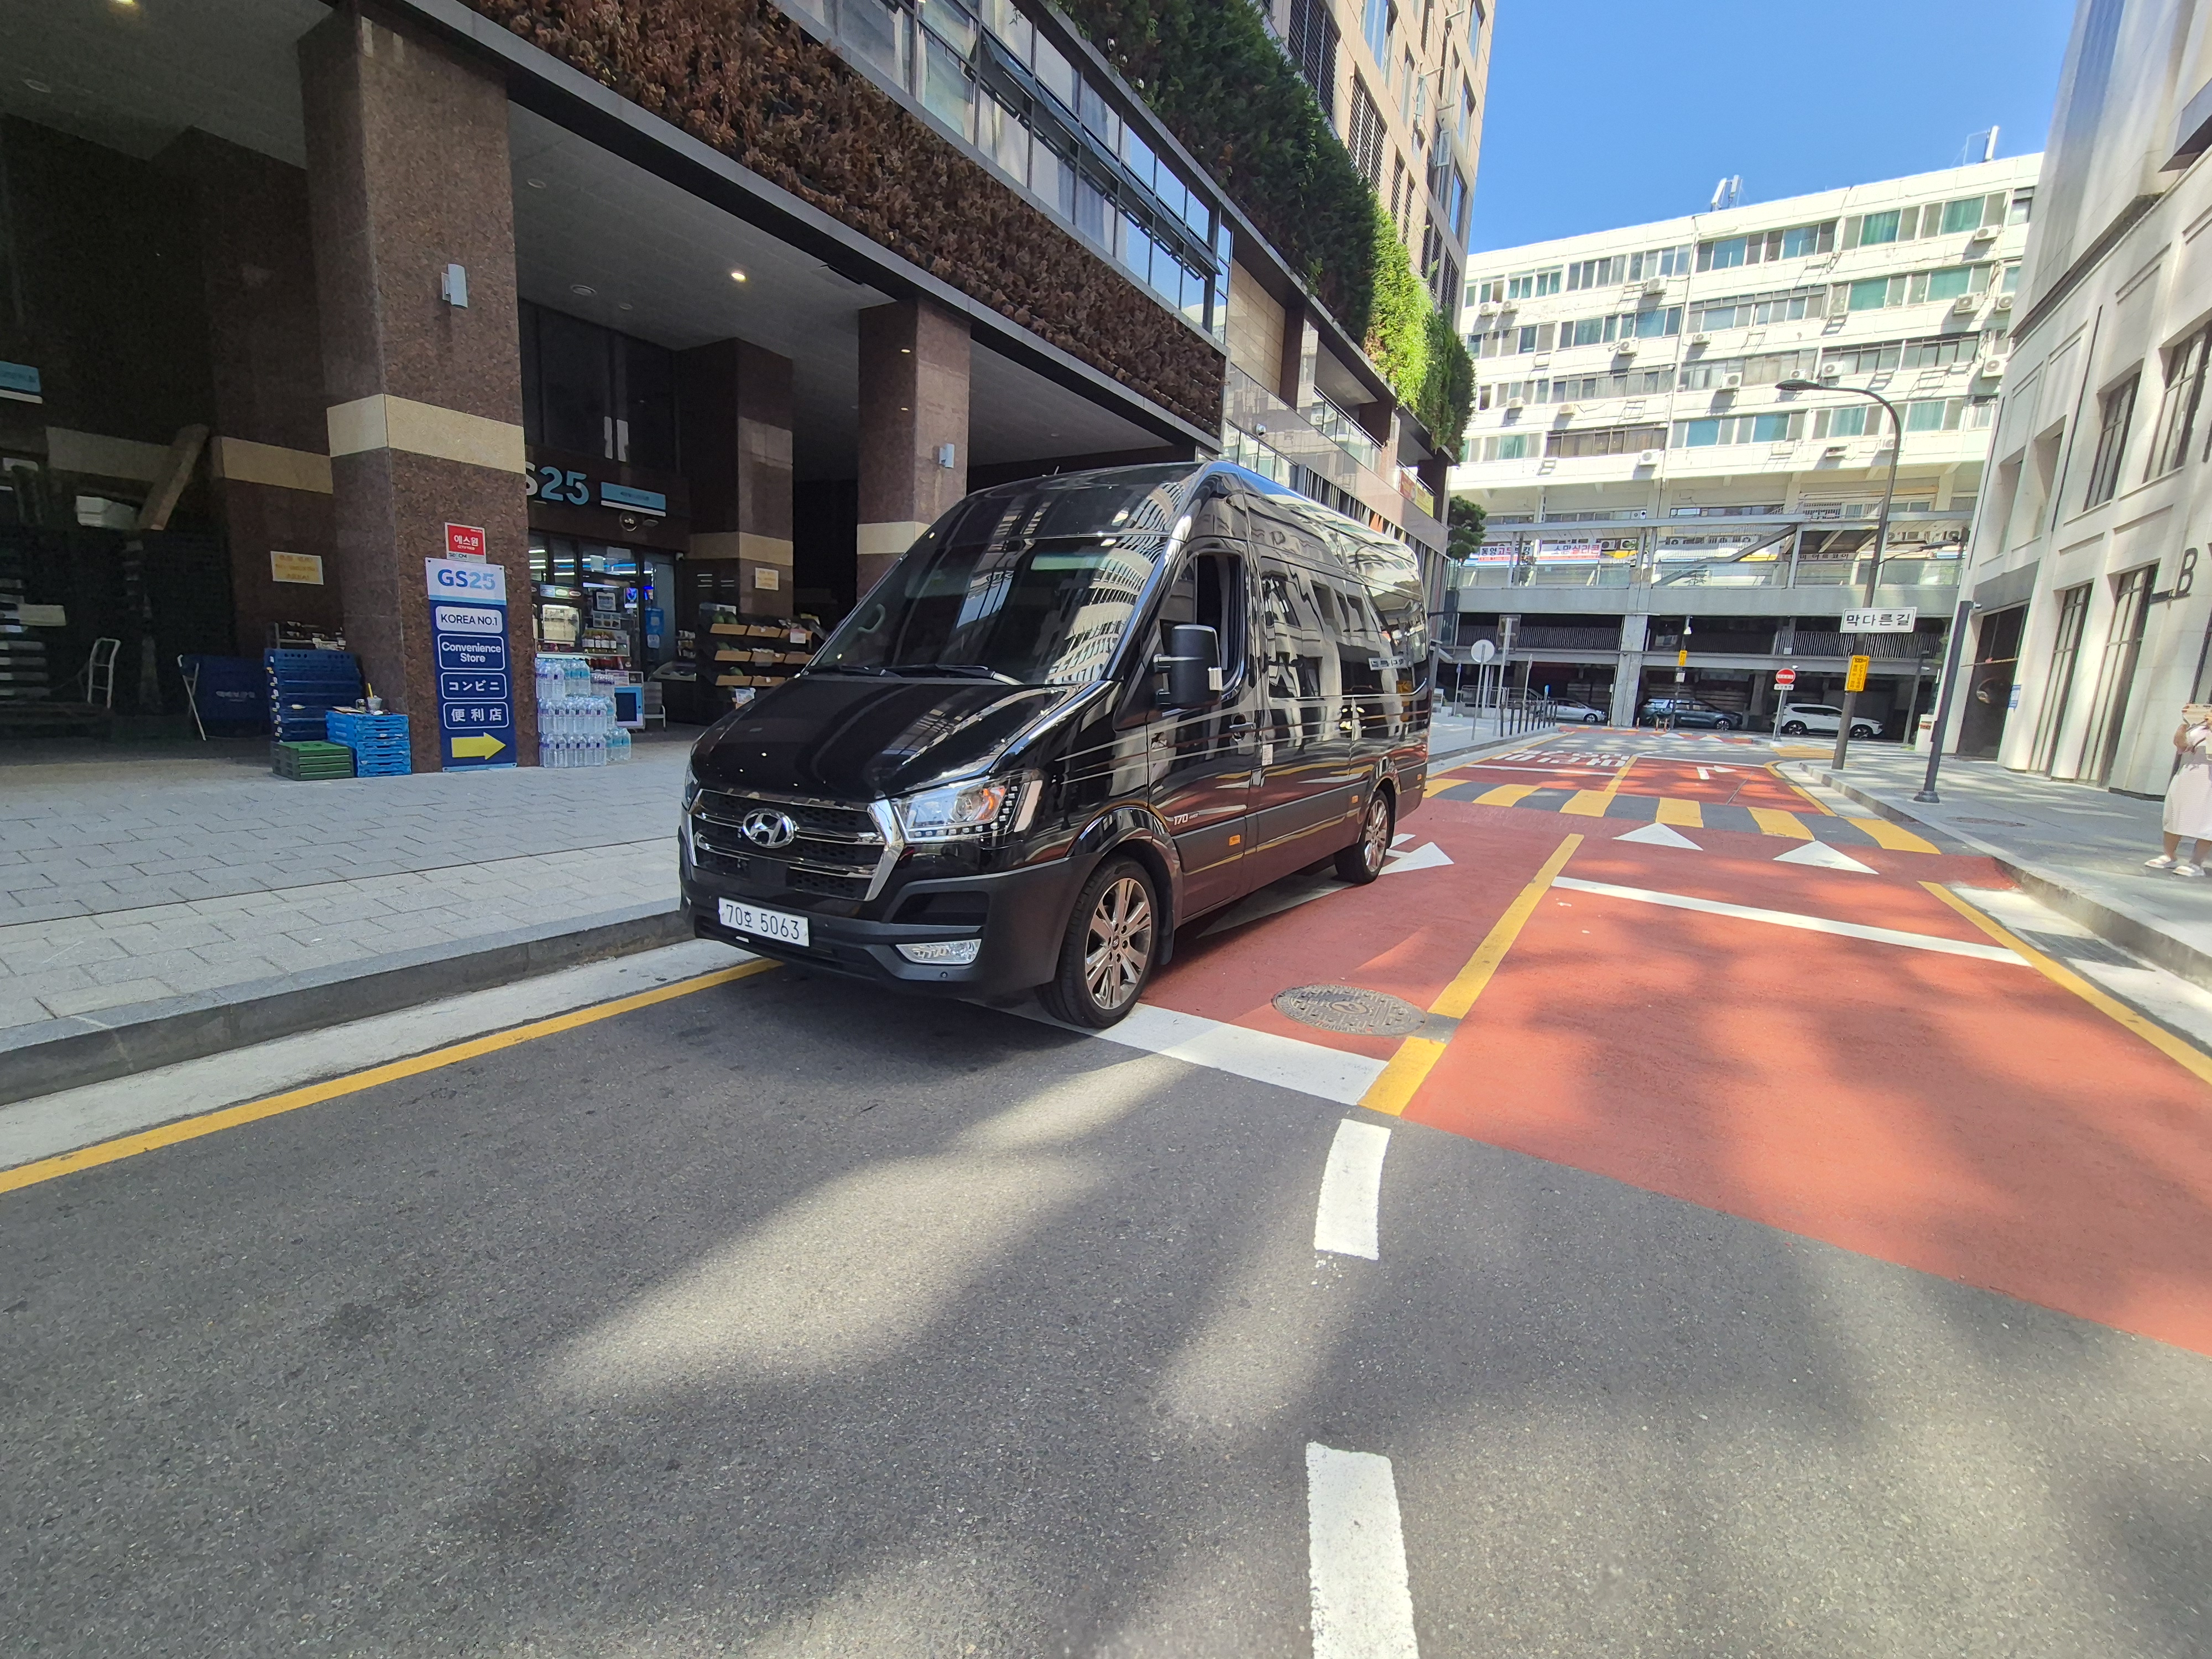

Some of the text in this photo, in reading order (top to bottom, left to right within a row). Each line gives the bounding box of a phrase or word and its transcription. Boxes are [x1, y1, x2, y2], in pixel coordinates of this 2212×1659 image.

[2176, 547, 2198, 598] B
[437, 568, 496, 591] GS25
[441, 614, 498, 626] KOREA NO.1
[1846, 613, 1911, 627] 막다른길
[441, 641, 502, 653] Convenience
[460, 653, 486, 662] Store
[448, 680, 500, 691] コンビニ
[451, 707, 502, 722] 便利店
[1173, 813, 1188, 826] 170
[726, 904, 800, 940] 70호 5063
